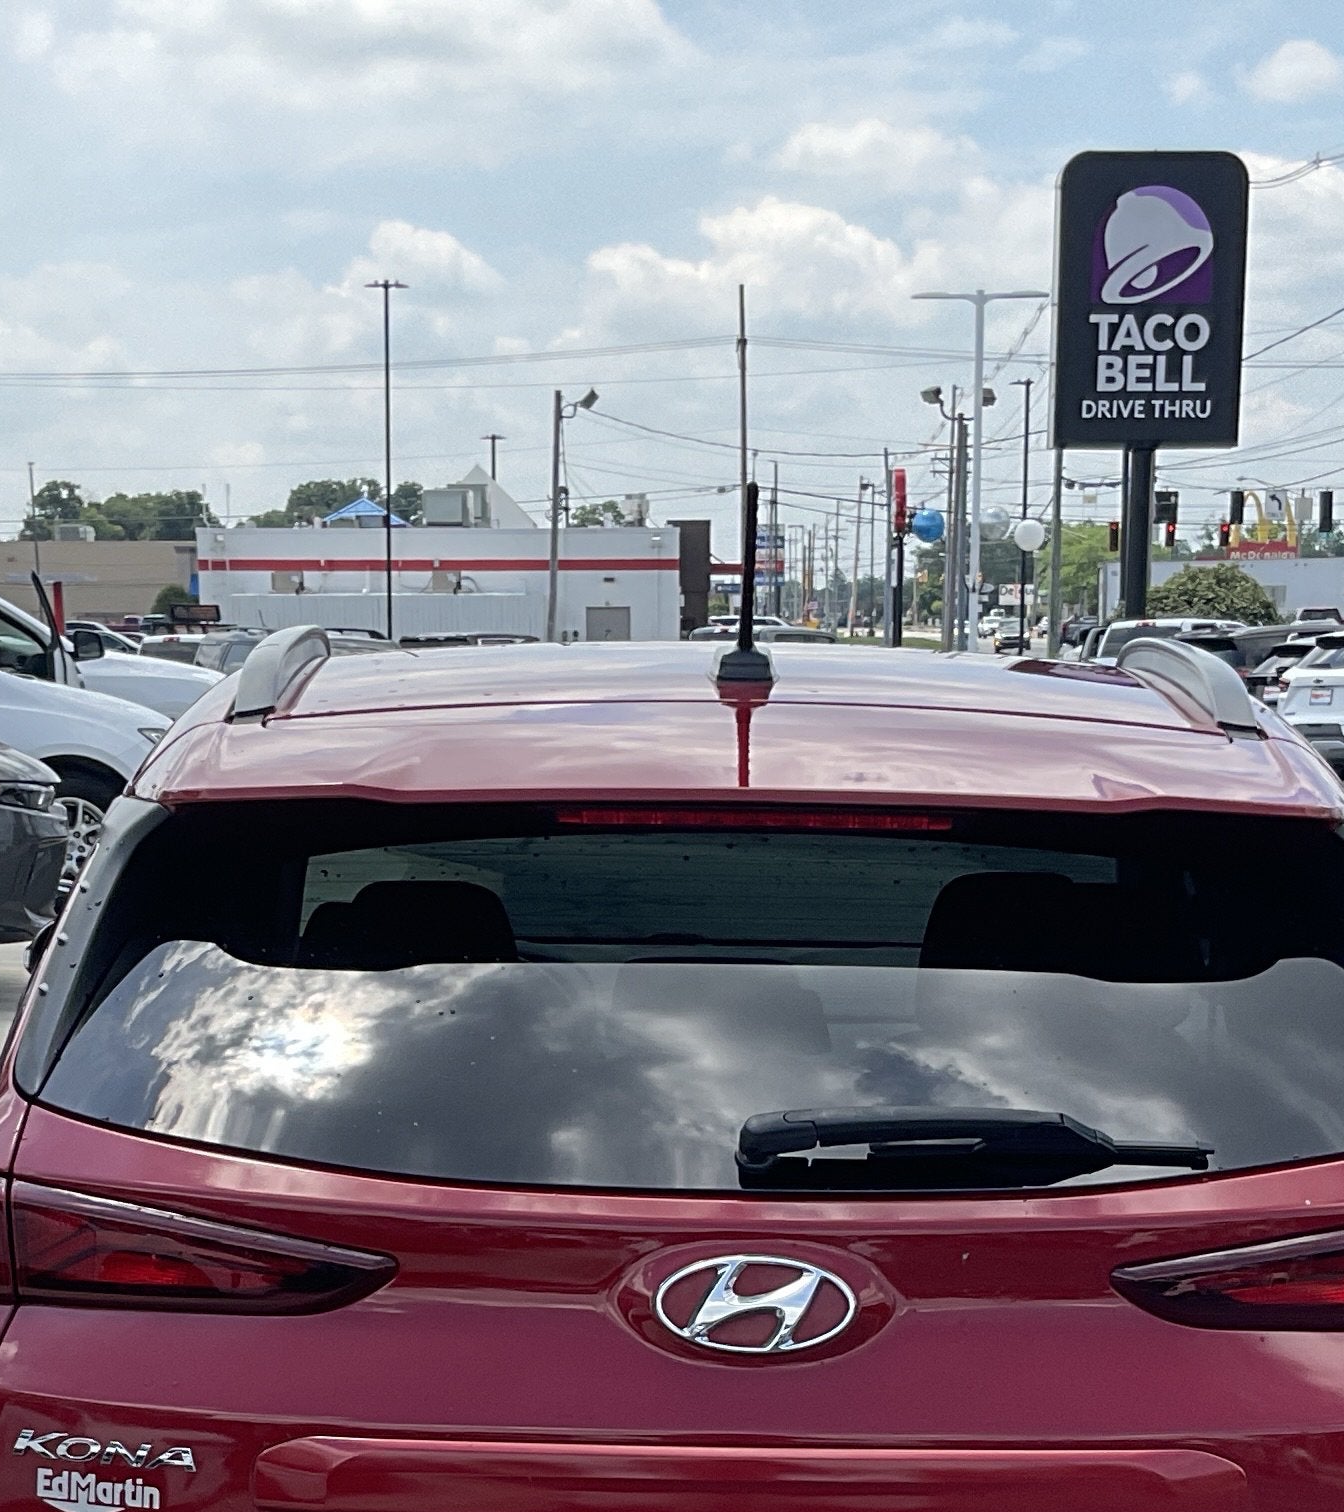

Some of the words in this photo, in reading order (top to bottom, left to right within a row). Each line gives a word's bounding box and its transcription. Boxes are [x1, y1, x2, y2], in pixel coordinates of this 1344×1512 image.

[1089, 313, 1211, 351] TACO
[1096, 354, 1207, 392] BELL
[1081, 400, 1146, 419] DRIVE
[1151, 400, 1212, 419] THRU
[12, 1428, 197, 1473] KONA
[36, 1466, 161, 1511] EdMartin
